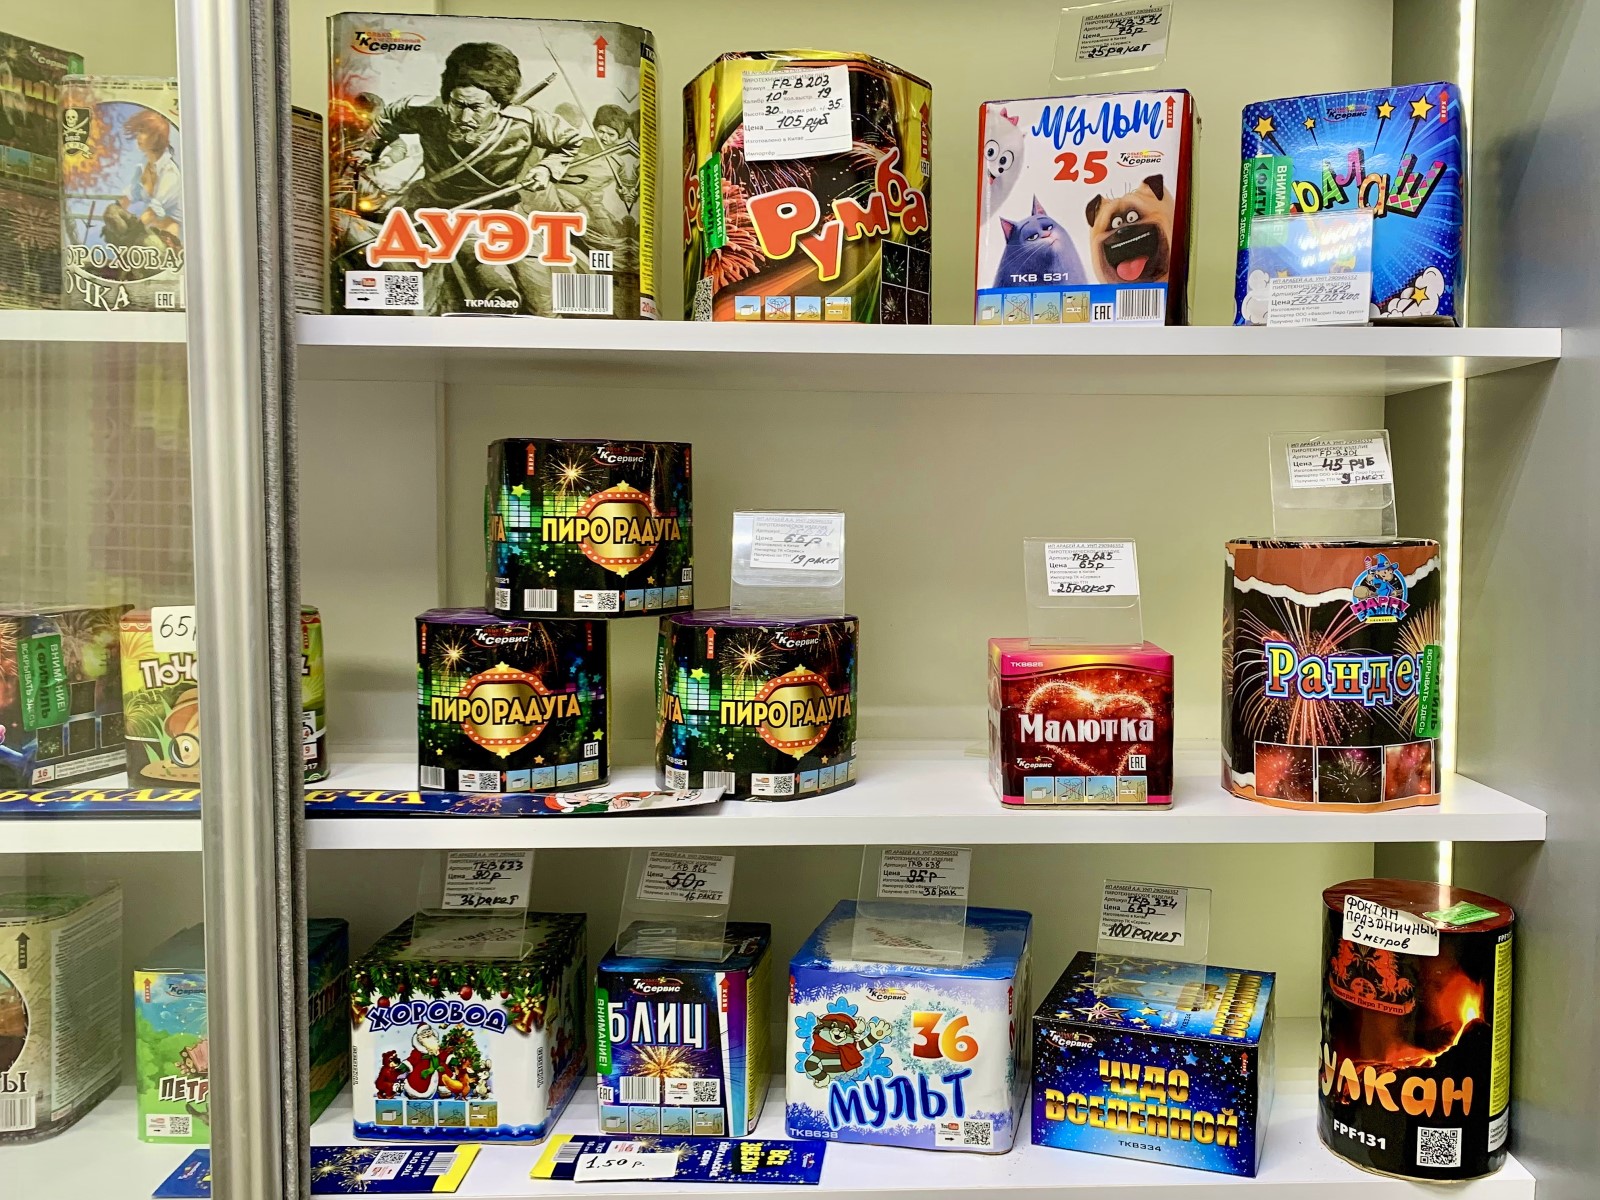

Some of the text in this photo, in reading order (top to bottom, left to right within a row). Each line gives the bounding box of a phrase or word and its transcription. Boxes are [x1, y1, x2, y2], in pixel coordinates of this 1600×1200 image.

[368, 42, 422, 52] Сервис
[818, 87, 832, 98] 19
[765, 106, 780, 116] 30
[828, 98, 842, 110] 35
[744, 113, 830, 132] Цена 105 руб
[1053, 150, 1108, 184] 25
[368, 208, 587, 266] ДУЭТ
[1044, 272, 1069, 282] 531
[608, 454, 644, 464] Сервис
[1322, 458, 1344, 471] 45
[1341, 473, 1350, 484] 9
[1350, 596, 1410, 616] HAPPY
[486, 635, 529, 645] Сервис
[786, 638, 820, 648] Сервис
[1265, 641, 1421, 706] Ранде
[1422, 648, 1434, 702] ВСКРЫВАТЬ
[431, 693, 582, 725] ПИРО РАДУГА
[720, 702, 788, 727] ПИРО
[1418, 703, 1428, 734] ЗДЕСЬ
[1018, 714, 1154, 743] Малютка
[38, 770, 48, 778] 16
[1024, 761, 1052, 769] Сервис
[1108, 924, 1132, 938] 100
[1352, 925, 1364, 938] 5
[642, 985, 680, 993] Сервис
[367, 1000, 508, 1034] ХОРОВОД
[1378, 1004, 1404, 1014] Групп
[597, 998, 608, 1067] ВНИМАНИЕ!
[608, 1002, 705, 1050] БЛИЦ
[912, 1012, 979, 1063] 36
[1058, 1039, 1092, 1049] Сервис
[1099, 1060, 1190, 1103] ЧУДО
[1334, 1118, 1386, 1150] FPF131
[766, 1150, 790, 1166] ВСЕ
